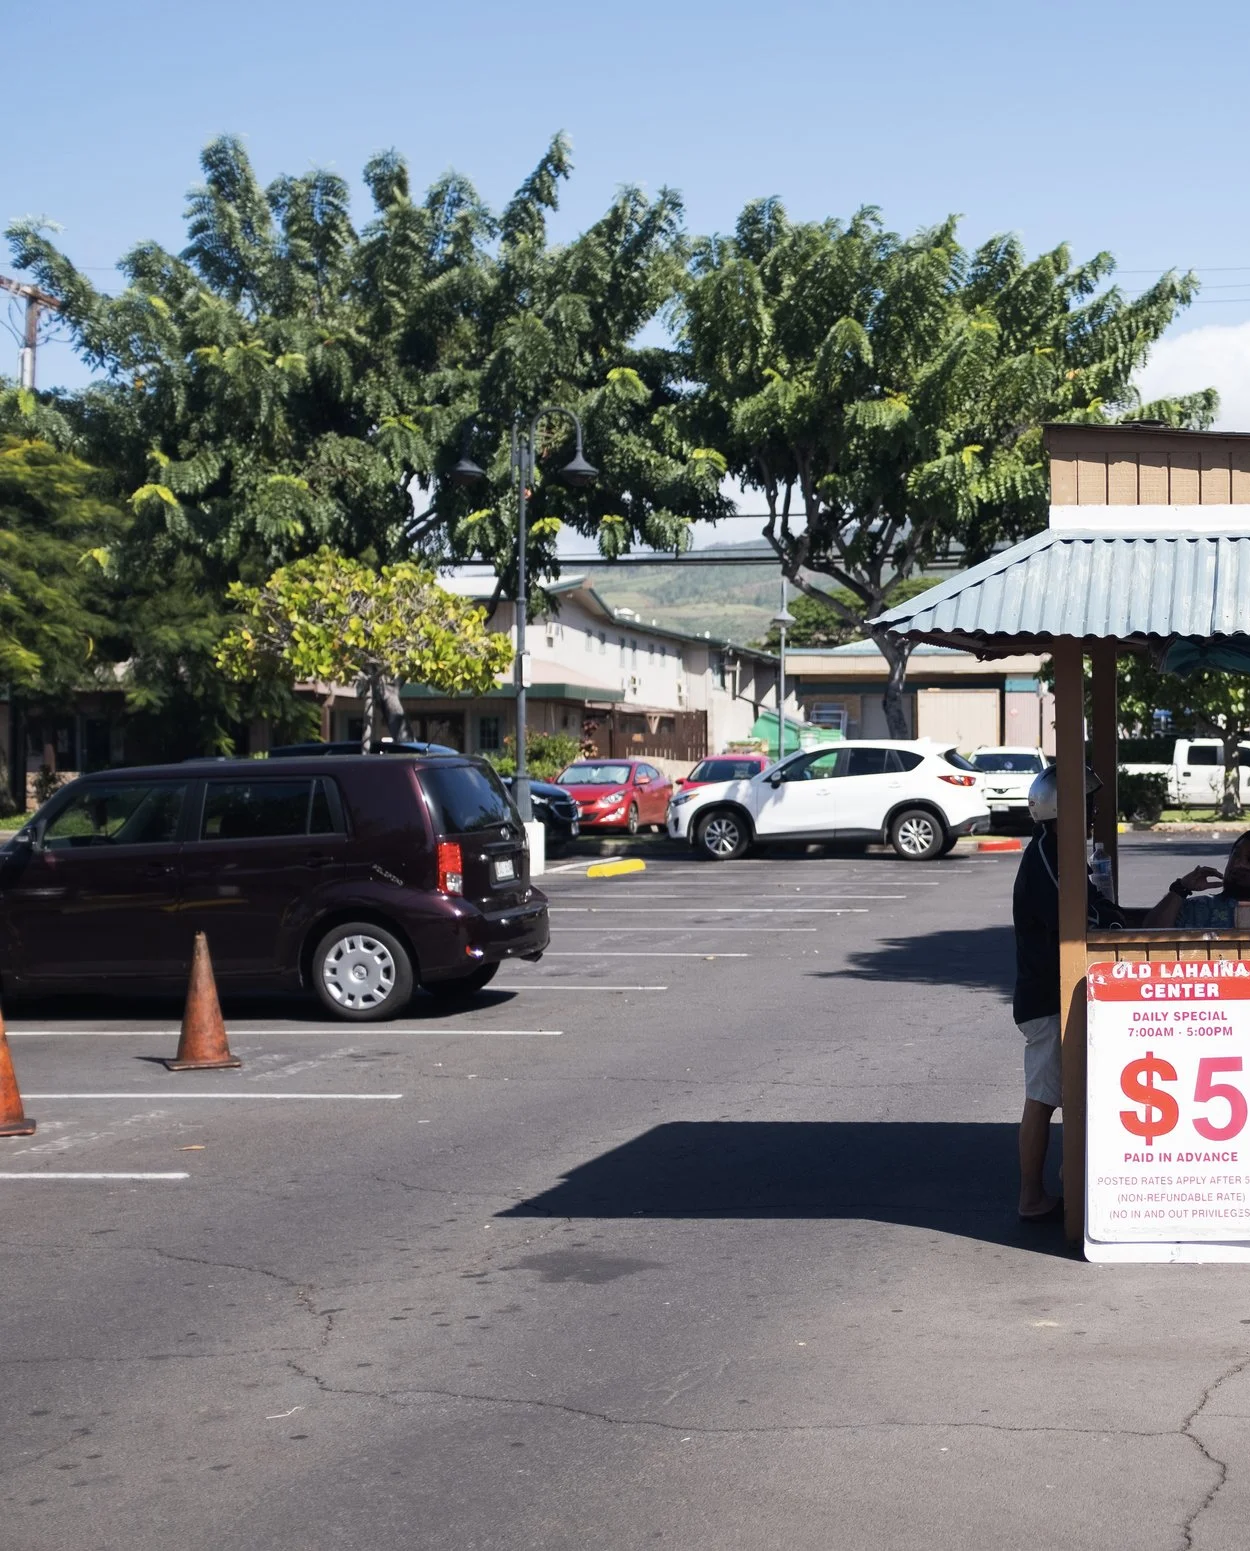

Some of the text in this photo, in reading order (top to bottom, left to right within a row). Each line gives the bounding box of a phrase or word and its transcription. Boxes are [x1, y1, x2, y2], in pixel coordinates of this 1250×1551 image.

[1112, 962, 1249, 979] OLD LAHAINA
[1140, 983, 1220, 999] CENTER
[1132, 1011, 1228, 1022] DAILY SPECIAL
[1128, 1027, 1174, 1037] 7:00AM
[1186, 1026, 1233, 1036] 5:00PM
[1119, 1051, 1248, 1146] $5
[1124, 1152, 1238, 1162] PAID IN ADVANCE
[1141, 1176, 1173, 1185] RATES
[1176, 1176, 1207, 1185] APPLY
[1210, 1175, 1242, 1185] AFTER
[1117, 1192, 1246, 1204] (NON-REFUNDABLE RATE)
[1109, 1209, 1128, 1220] (NO
[1131, 1210, 1141, 1218] IN
[1144, 1210, 1165, 1218] AND
[1168, 1210, 1189, 1219] OUT
